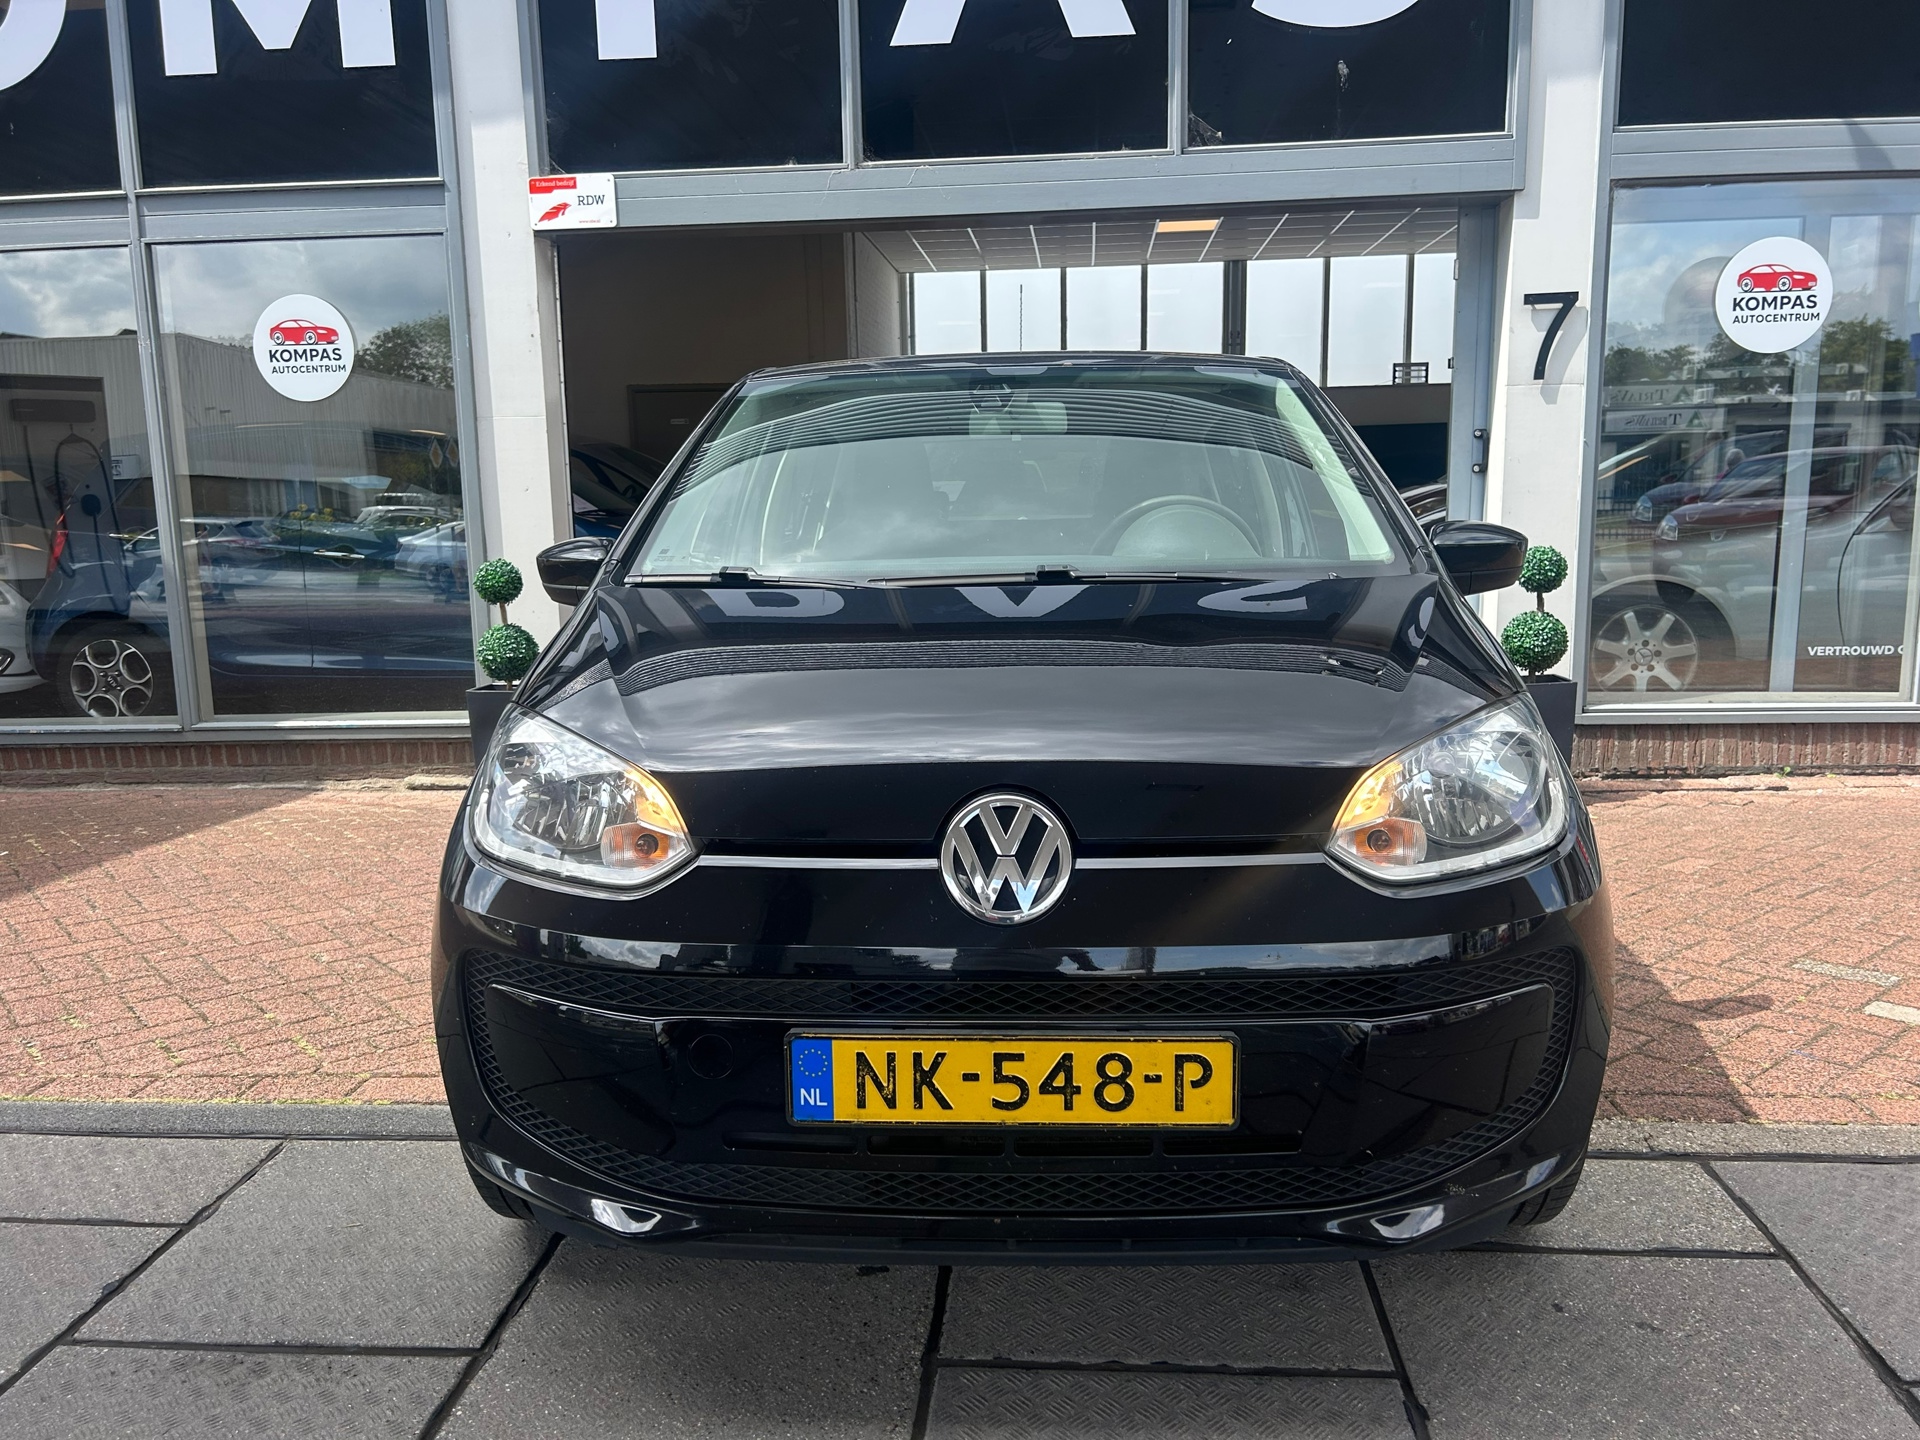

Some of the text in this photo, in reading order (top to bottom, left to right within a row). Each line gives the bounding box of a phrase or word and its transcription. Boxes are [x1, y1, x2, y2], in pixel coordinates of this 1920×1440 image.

[577, 195, 605, 206] RDW
[1732, 295, 1818, 312] KOMPAS
[1732, 313, 1820, 324] AUTOCENTRUM
[1524, 291, 1579, 381] 7
[269, 348, 342, 363] KOMPAS
[272, 364, 346, 374] AUTOCENTRUM
[1807, 645, 1895, 656] VERTROUWD
[855, 1051, 1214, 1112] NK-548-P
[800, 1088, 828, 1106] NL
